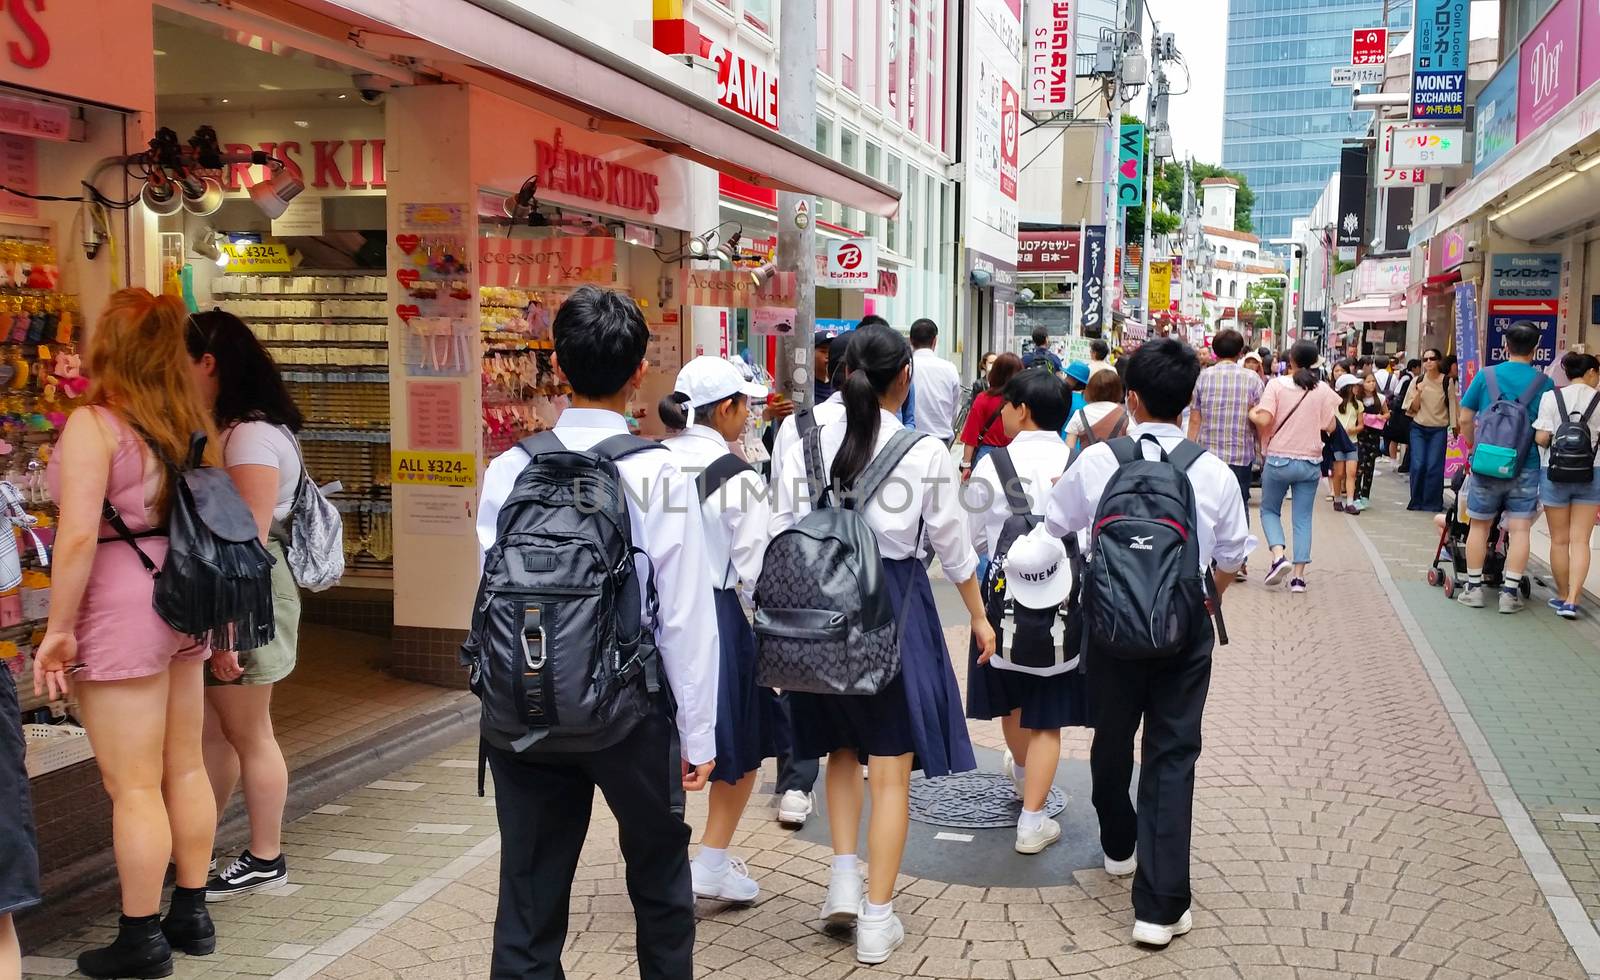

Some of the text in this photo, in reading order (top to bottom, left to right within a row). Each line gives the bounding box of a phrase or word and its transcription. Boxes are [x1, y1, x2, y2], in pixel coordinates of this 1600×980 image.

[1452, 4, 1463, 68] Coin Locker
[1360, 55, 1384, 63] アガサ
[1421, 58, 1429, 67] 1F
[1033, 28, 1047, 103] SELECT
[1530, 31, 1563, 107] D'or
[1416, 75, 1462, 90] MONEY
[1415, 92, 1462, 103] EXCHANGE
[1120, 130, 1139, 200] W C
[1042, 253, 1070, 262] 日本一
[1494, 268, 1559, 278] コインロッカー
[1500, 279, 1519, 287] Coin
[399, 458, 467, 473] ALL ¥324-
[434, 473, 472, 483] Paris kid's
[1019, 571, 1045, 582] LOVE
